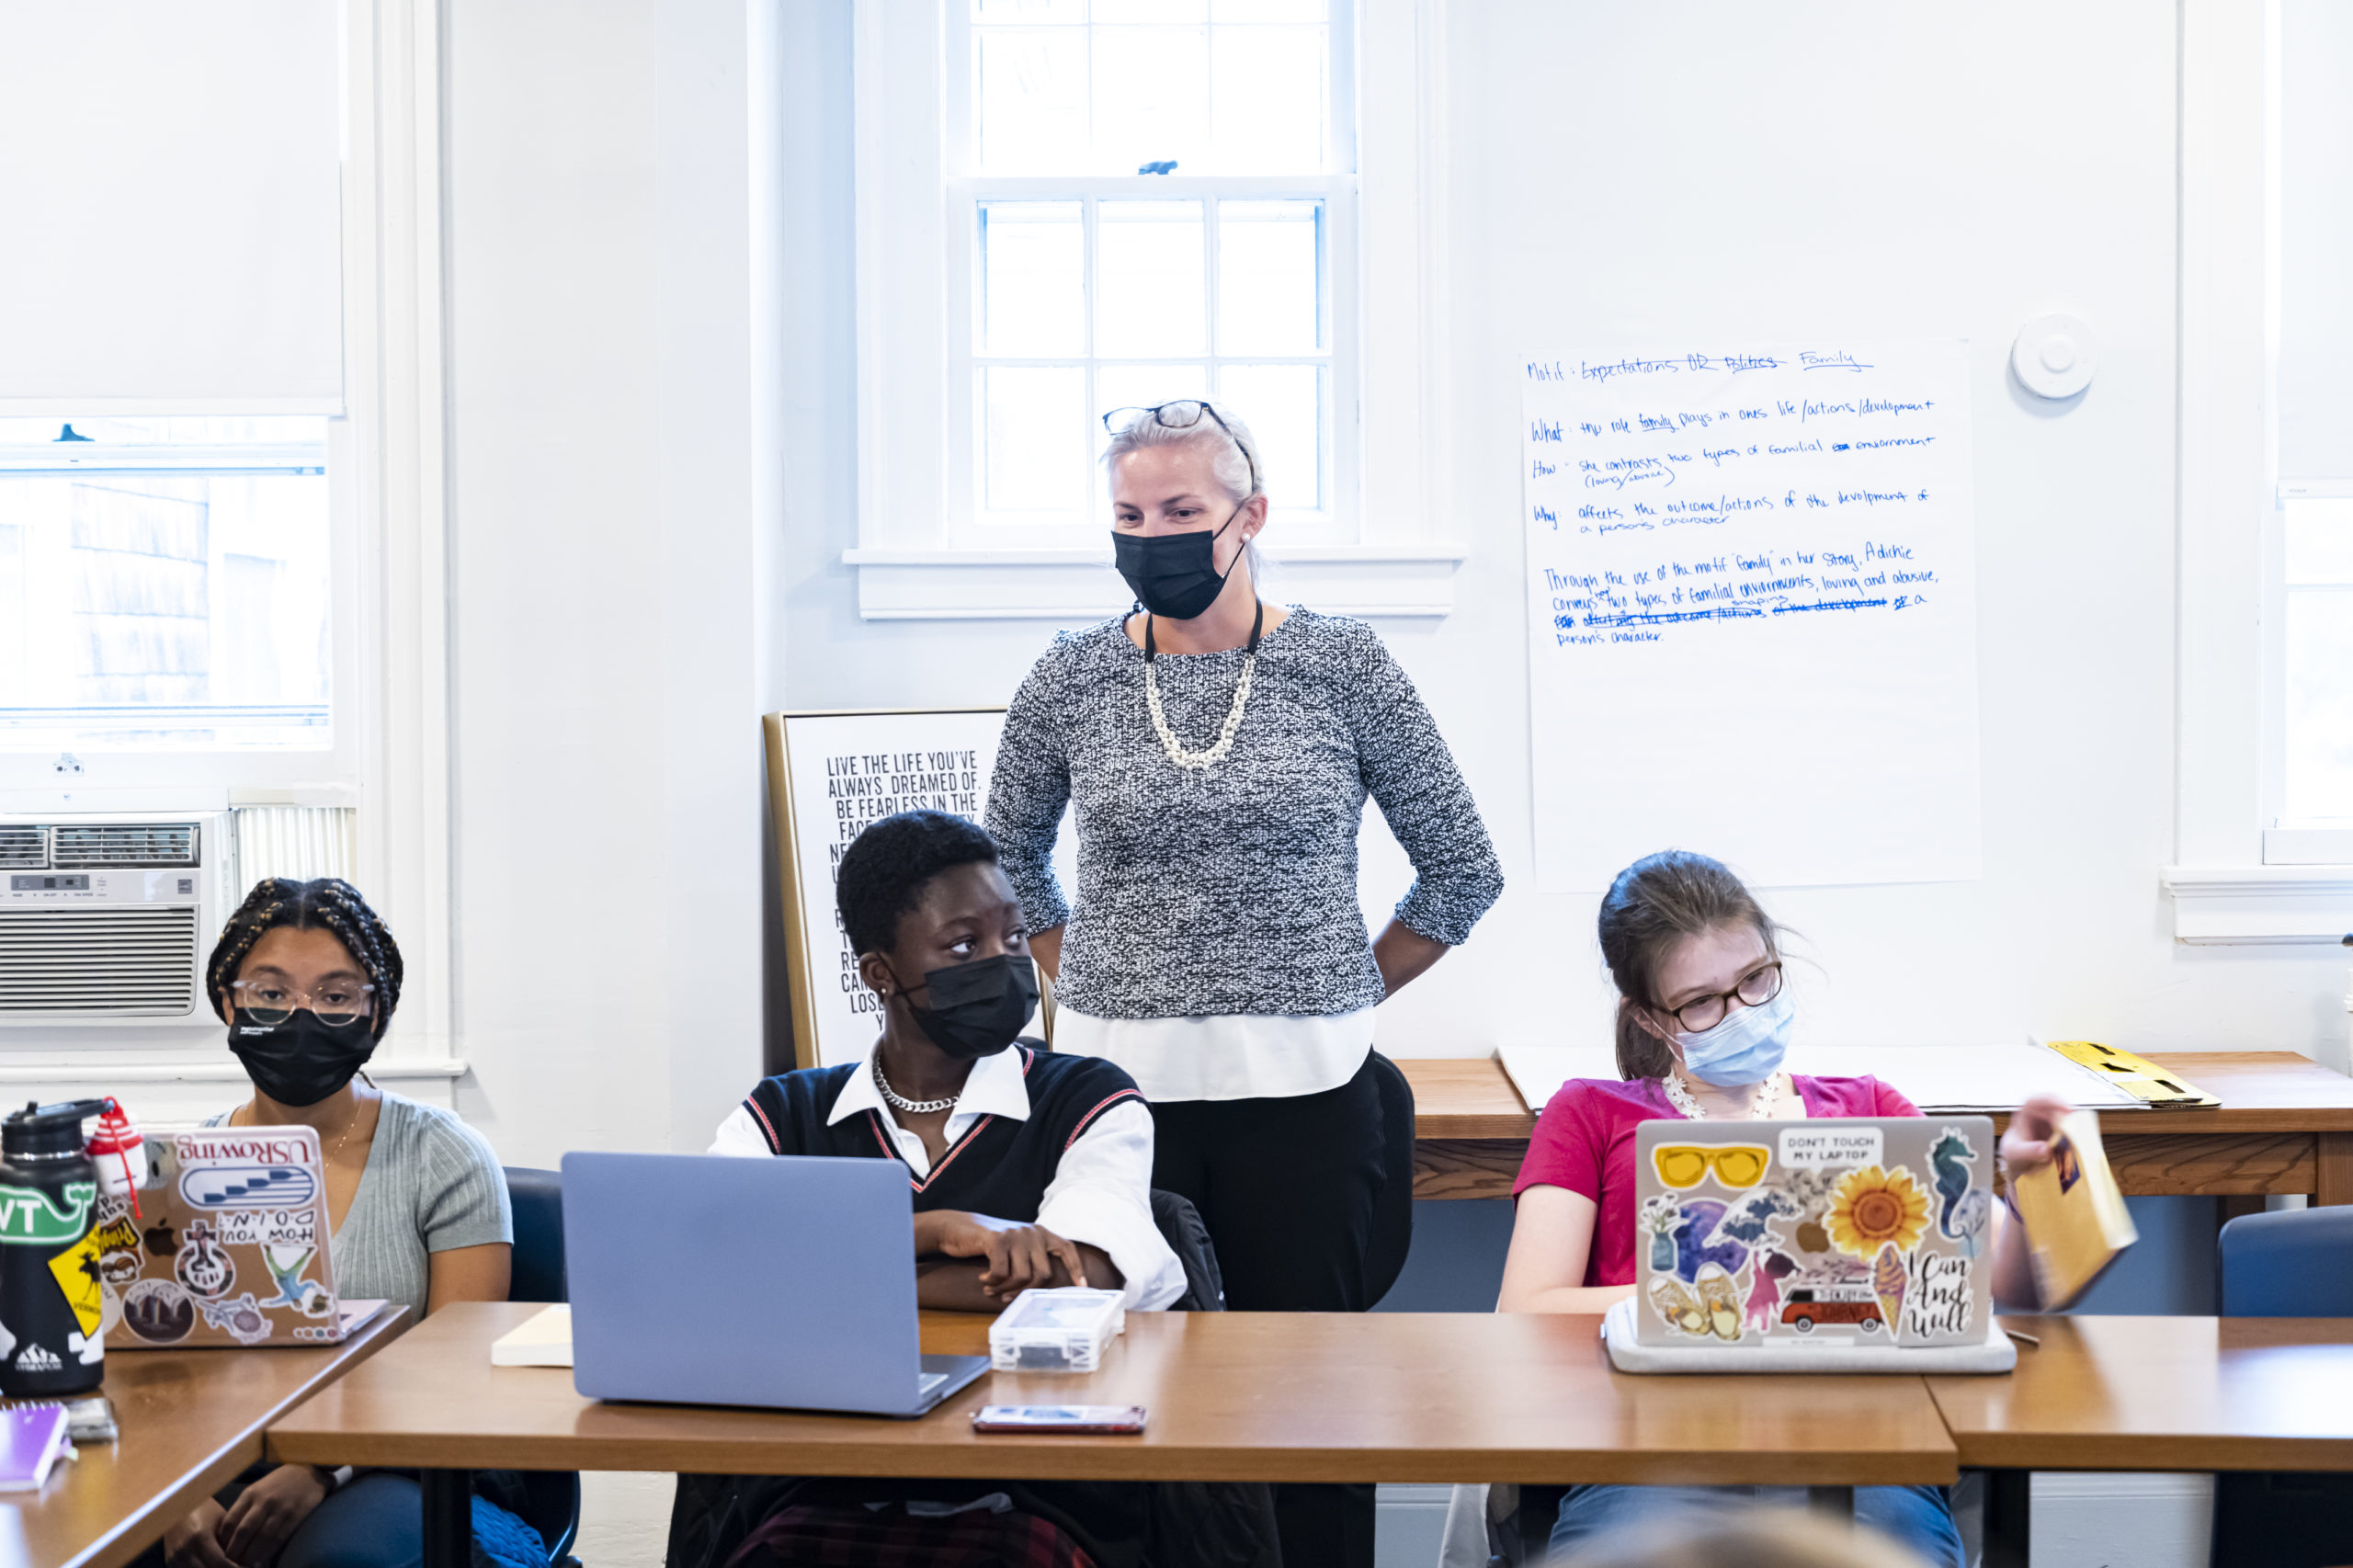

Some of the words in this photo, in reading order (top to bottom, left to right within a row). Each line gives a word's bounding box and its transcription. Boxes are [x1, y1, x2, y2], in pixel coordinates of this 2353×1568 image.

[1581, 357, 1679, 383] Expectations
[1799, 350, 1862, 373] Family
[1611, 418, 1631, 433] role
[1719, 411, 1730, 420] in
[1606, 456, 1663, 472] contrasts
[1667, 452, 1693, 463] two
[1703, 448, 1741, 467] types
[1747, 445, 1760, 455] of
[1768, 438, 1824, 455] familial
[1578, 504, 1624, 519] affects
[1634, 502, 1659, 516] the
[1784, 490, 1796, 507] of
[1806, 493, 1830, 508] the
[1917, 489, 1930, 501] of
[1580, 525, 1593, 534] a
[1662, 515, 1731, 527] character
[1543, 567, 1598, 595] Through
[1605, 570, 1628, 586] the
[1633, 571, 1652, 585] use
[1656, 564, 1667, 581] of
[1672, 561, 1694, 577] the
[1694, 556, 1728, 575] motif
[1779, 555, 1792, 566] in
[1796, 551, 1815, 565] her
[1865, 540, 1915, 562] Adichie
[1635, 590, 1667, 613] types
[1671, 586, 1685, 605] of
[1688, 582, 1734, 604] familial
[1821, 574, 1865, 597] loving
[1863, 570, 1887, 587] and
[1610, 631, 1665, 643] character.
[826, 756, 858, 777] LIVE
[861, 754, 890, 775] THE
[893, 752, 924, 773] LIFE
[927, 750, 978, 771] YOU'VE
[828, 776, 883, 798] ALWAYS
[891, 772, 958, 795] DREAMED
[961, 771, 982, 790] OF.
[835, 800, 855, 819] BE
[858, 795, 928, 819] FEARLESS
[932, 794, 948, 812] IN
[950, 792, 978, 812] THE
[176, 1135, 310, 1166] USRowing
[1788, 1137, 1826, 1148] DON'T
[1833, 1137, 1875, 1147] TOUCH
[1794, 1152, 1813, 1161] MY
[1819, 1151, 1869, 1161] LAPTOP
[225, 1229, 256, 1242] YOU
[268, 1227, 314, 1241] HOW
[1908, 1251, 1915, 1278] I
[1921, 1252, 1967, 1282] Can
[1907, 1278, 1965, 1310] And
[1908, 1301, 1971, 1338] Will
